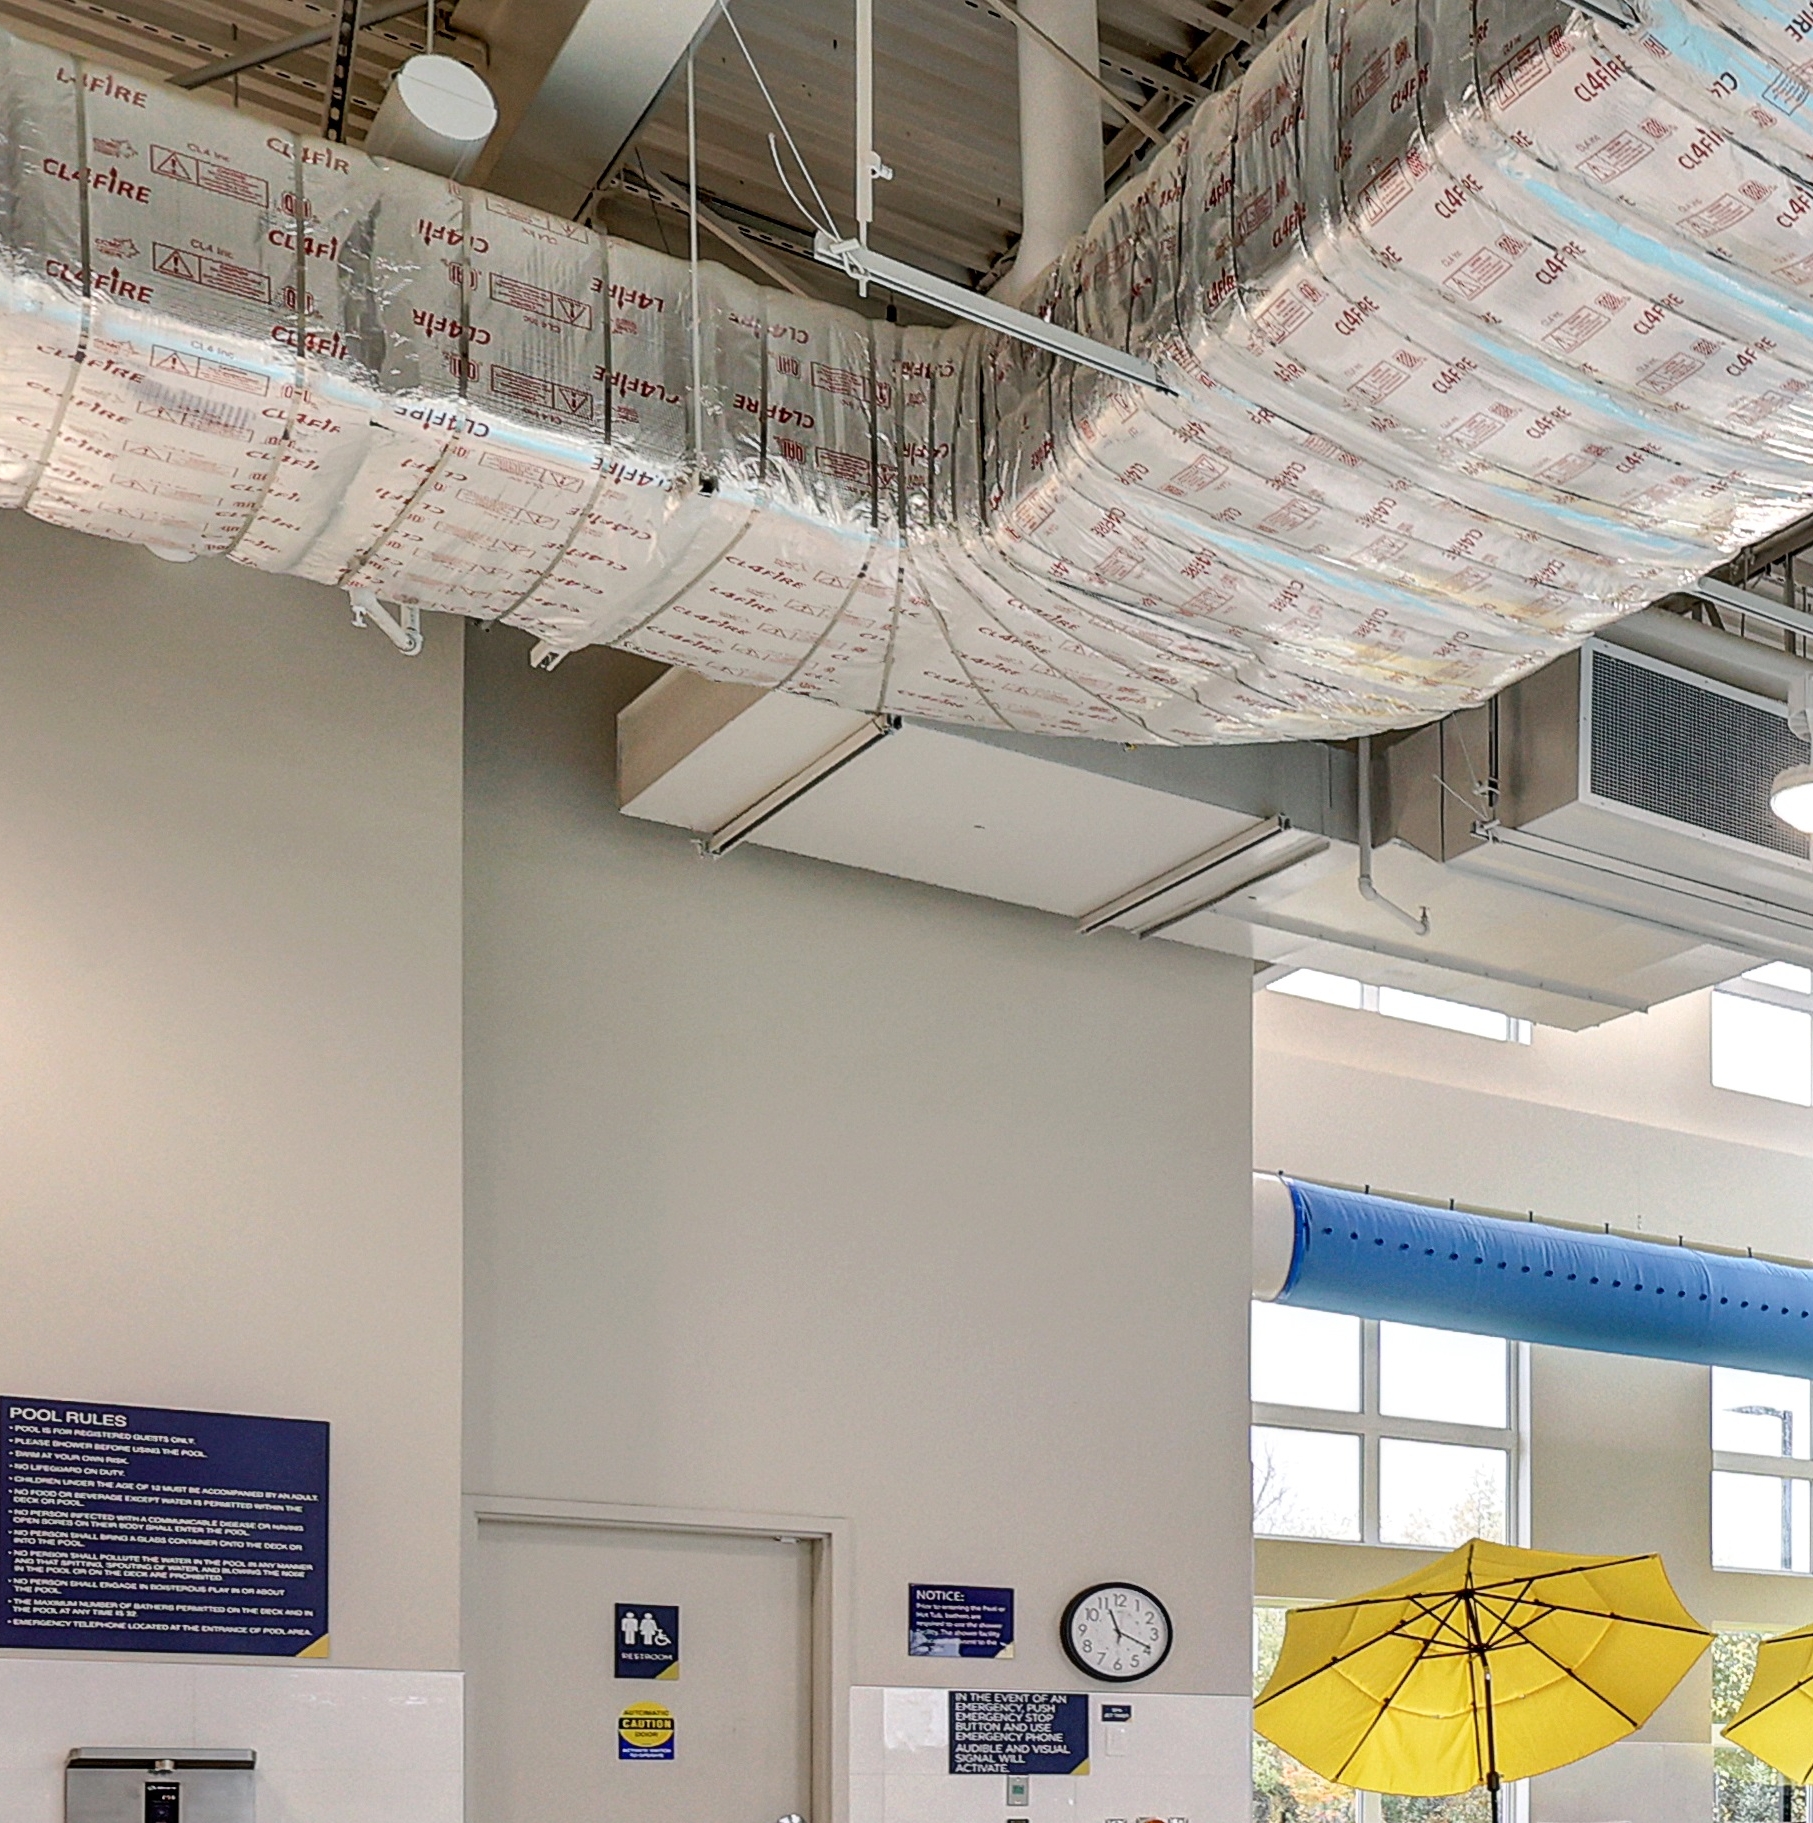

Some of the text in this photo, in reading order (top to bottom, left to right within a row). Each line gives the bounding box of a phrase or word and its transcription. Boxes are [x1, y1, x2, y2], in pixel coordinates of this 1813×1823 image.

[10, 1407, 127, 1427] POOL RULES
[15, 1425, 40, 1433] POOL
[74, 1429, 131, 1440] REGISTERED
[133, 1434, 169, 1442] GUESTS
[14, 1438, 50, 1446] PLEASE
[52, 1440, 92, 1449] SHOWER
[94, 1444, 130, 1452] BEFORE
[14, 1476, 61, 1485] CHILDREN
[62, 1479, 94, 1487] UNDER
[14, 1488, 28, 1496] NO
[30, 1489, 56, 1497] FOOD
[74, 1492, 122, 1501] BEVERAGE
[125, 1494, 160, 1504] EXCEPT
[162, 1497, 192, 1506] WATER
[204, 1500, 252, 1509] PERMITTED
[254, 1503, 284, 1511] WITHIN
[286, 1505, 303, 1513] THE
[916, 1590, 965, 1601] NOTICE:
[1113, 1593, 1127, 1607] 12
[1098, 1597, 1109, 1610] 11
[1135, 1599, 1139, 1612] 1
[1085, 1608, 1099, 1621] 10
[1145, 1611, 1154, 1624] 2
[13, 1618, 72, 1627] EMERGENCY
[74, 1621, 126, 1629] TELEPHONE
[128, 1623, 169, 1631] LOCATED
[202, 1626, 247, 1634] ENTRANCE
[1078, 1624, 1087, 1637] 9
[1150, 1628, 1159, 1641] 3
[1082, 1639, 1092, 1653] 8
[621, 1652, 673, 1660] RESTROOM
[1097, 1652, 1106, 1665] 7
[1130, 1655, 1139, 1667] 5
[1113, 1658, 1122, 1670] 6
[955, 1693, 1067, 1704] IN THE EVENT OF AN
[955, 1703, 1055, 1713] EMERGENCY, PUSH
[955, 1713, 1054, 1722] EMERGENCY STOP
[622, 1720, 671, 1728] CAUTION
[955, 1723, 1052, 1732] BUTTON AND USE
[955, 1732, 1063, 1742] EMERGENCY PHONE
[955, 1744, 1071, 1754] AUDIBLE AND VISUAL
[955, 1754, 1026, 1763] SIGNAL WILL
[955, 1764, 1010, 1773] ACTIVATE.
